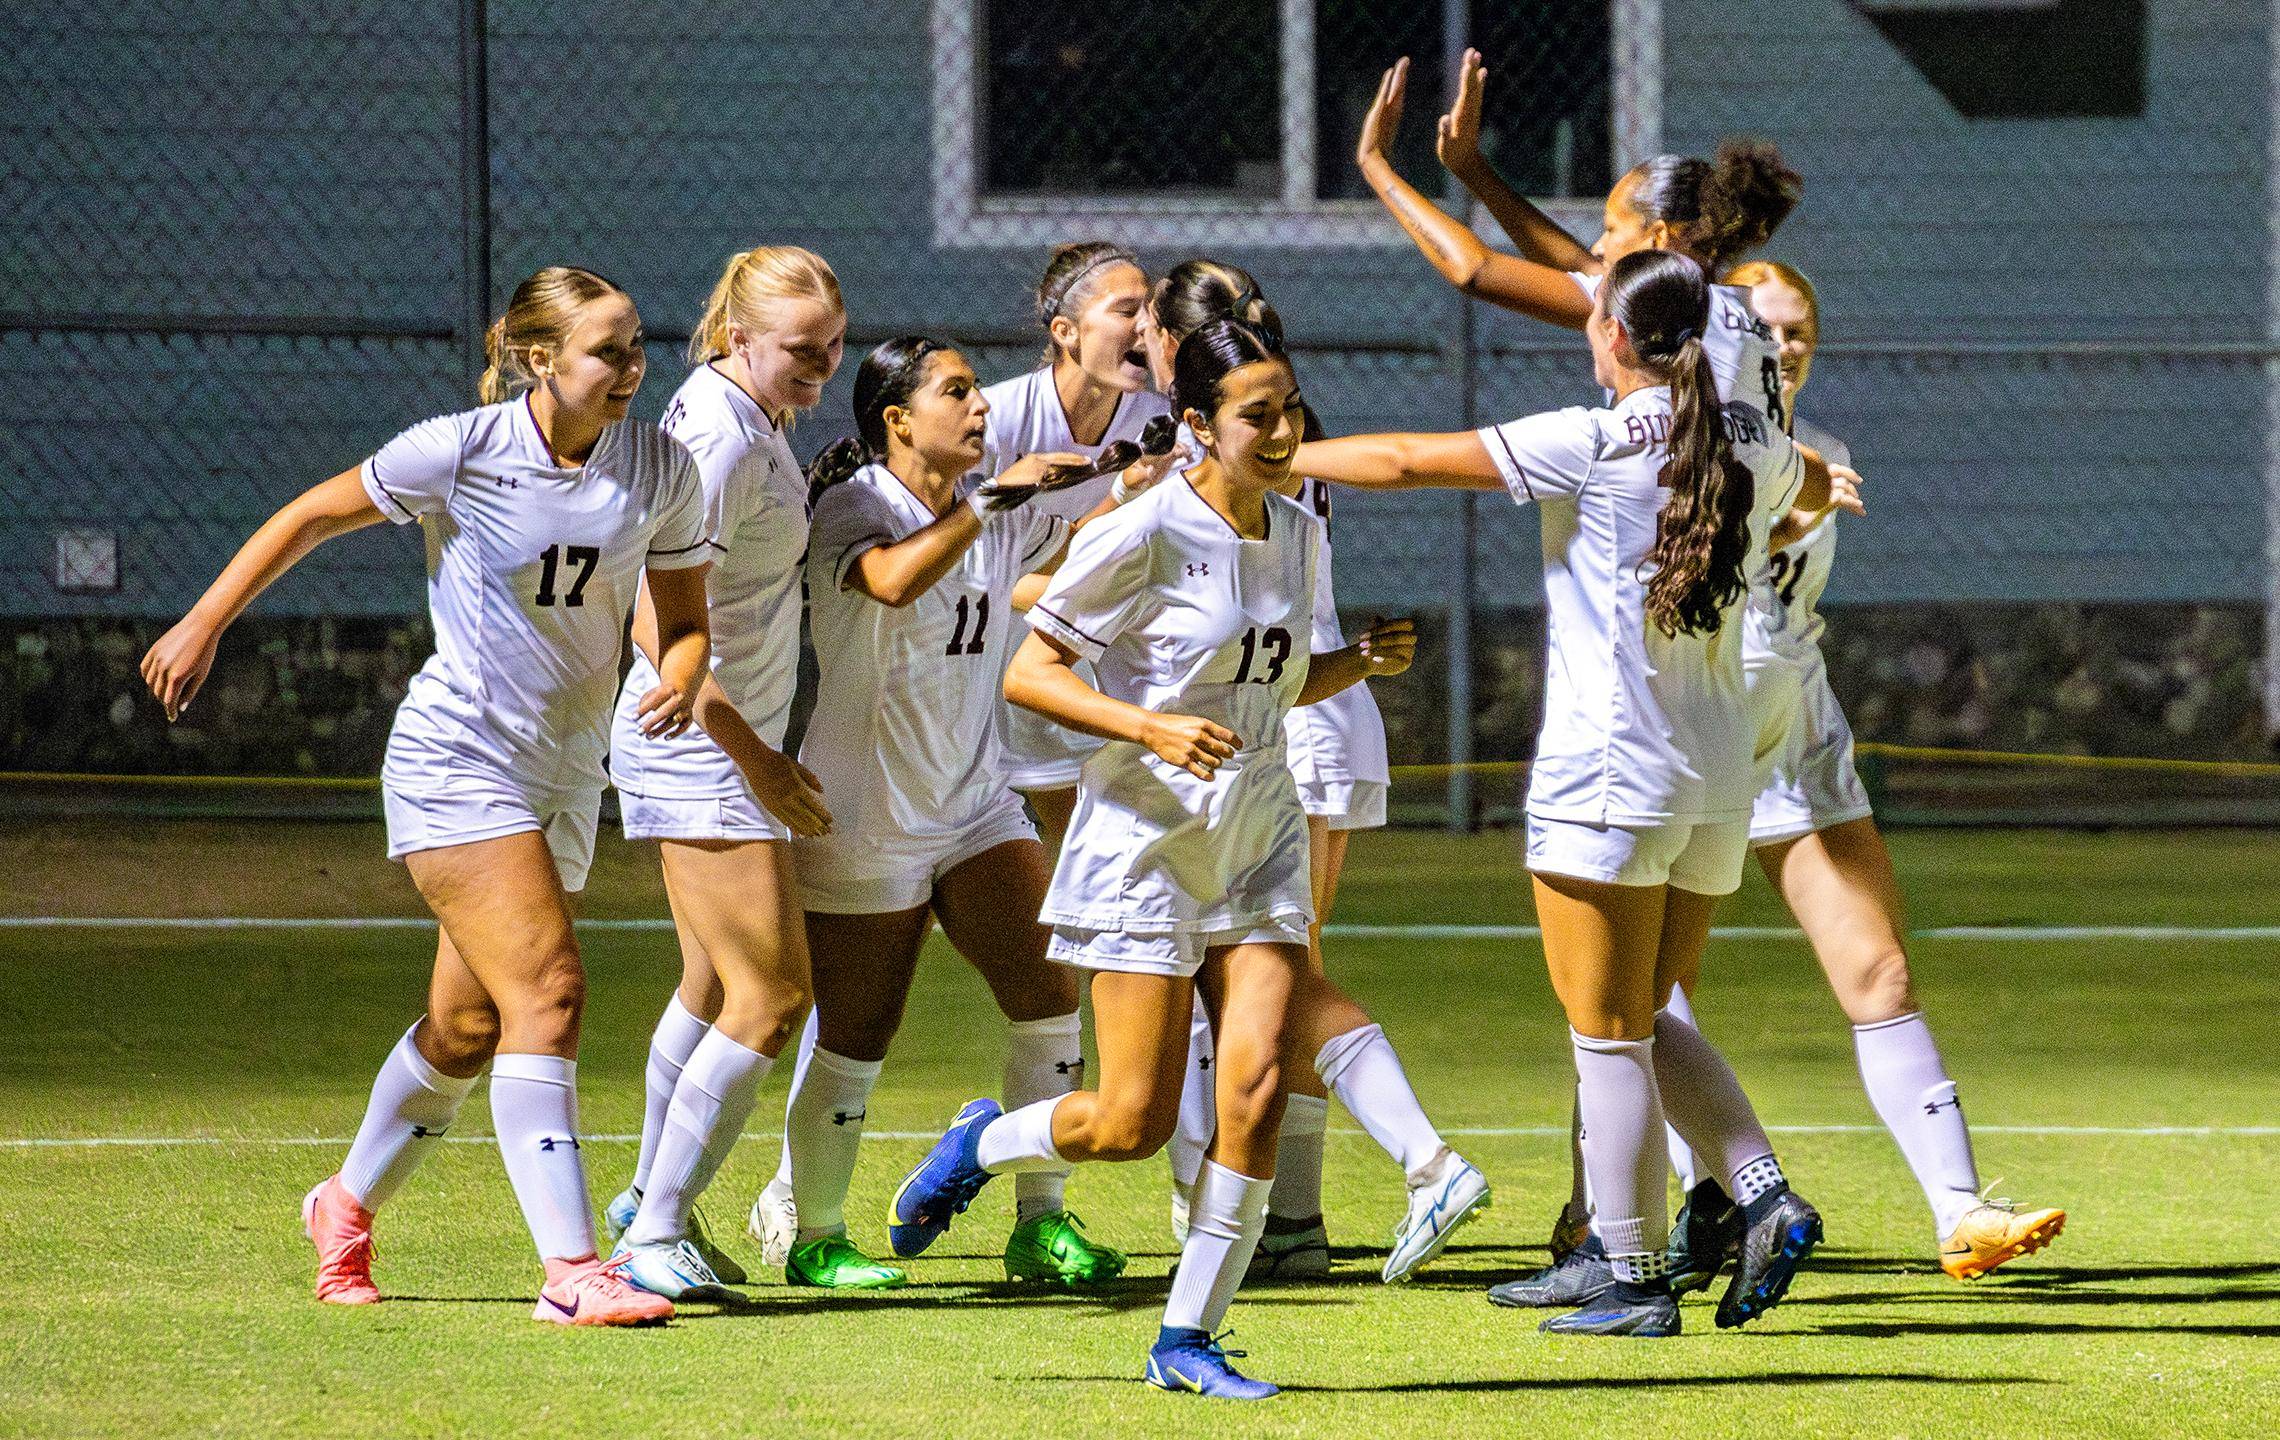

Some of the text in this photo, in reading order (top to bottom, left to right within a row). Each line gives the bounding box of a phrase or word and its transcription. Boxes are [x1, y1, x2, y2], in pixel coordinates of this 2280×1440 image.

[535, 543, 600, 608] 17
[945, 592, 989, 656] 11
[1232, 627, 1292, 685] 13
